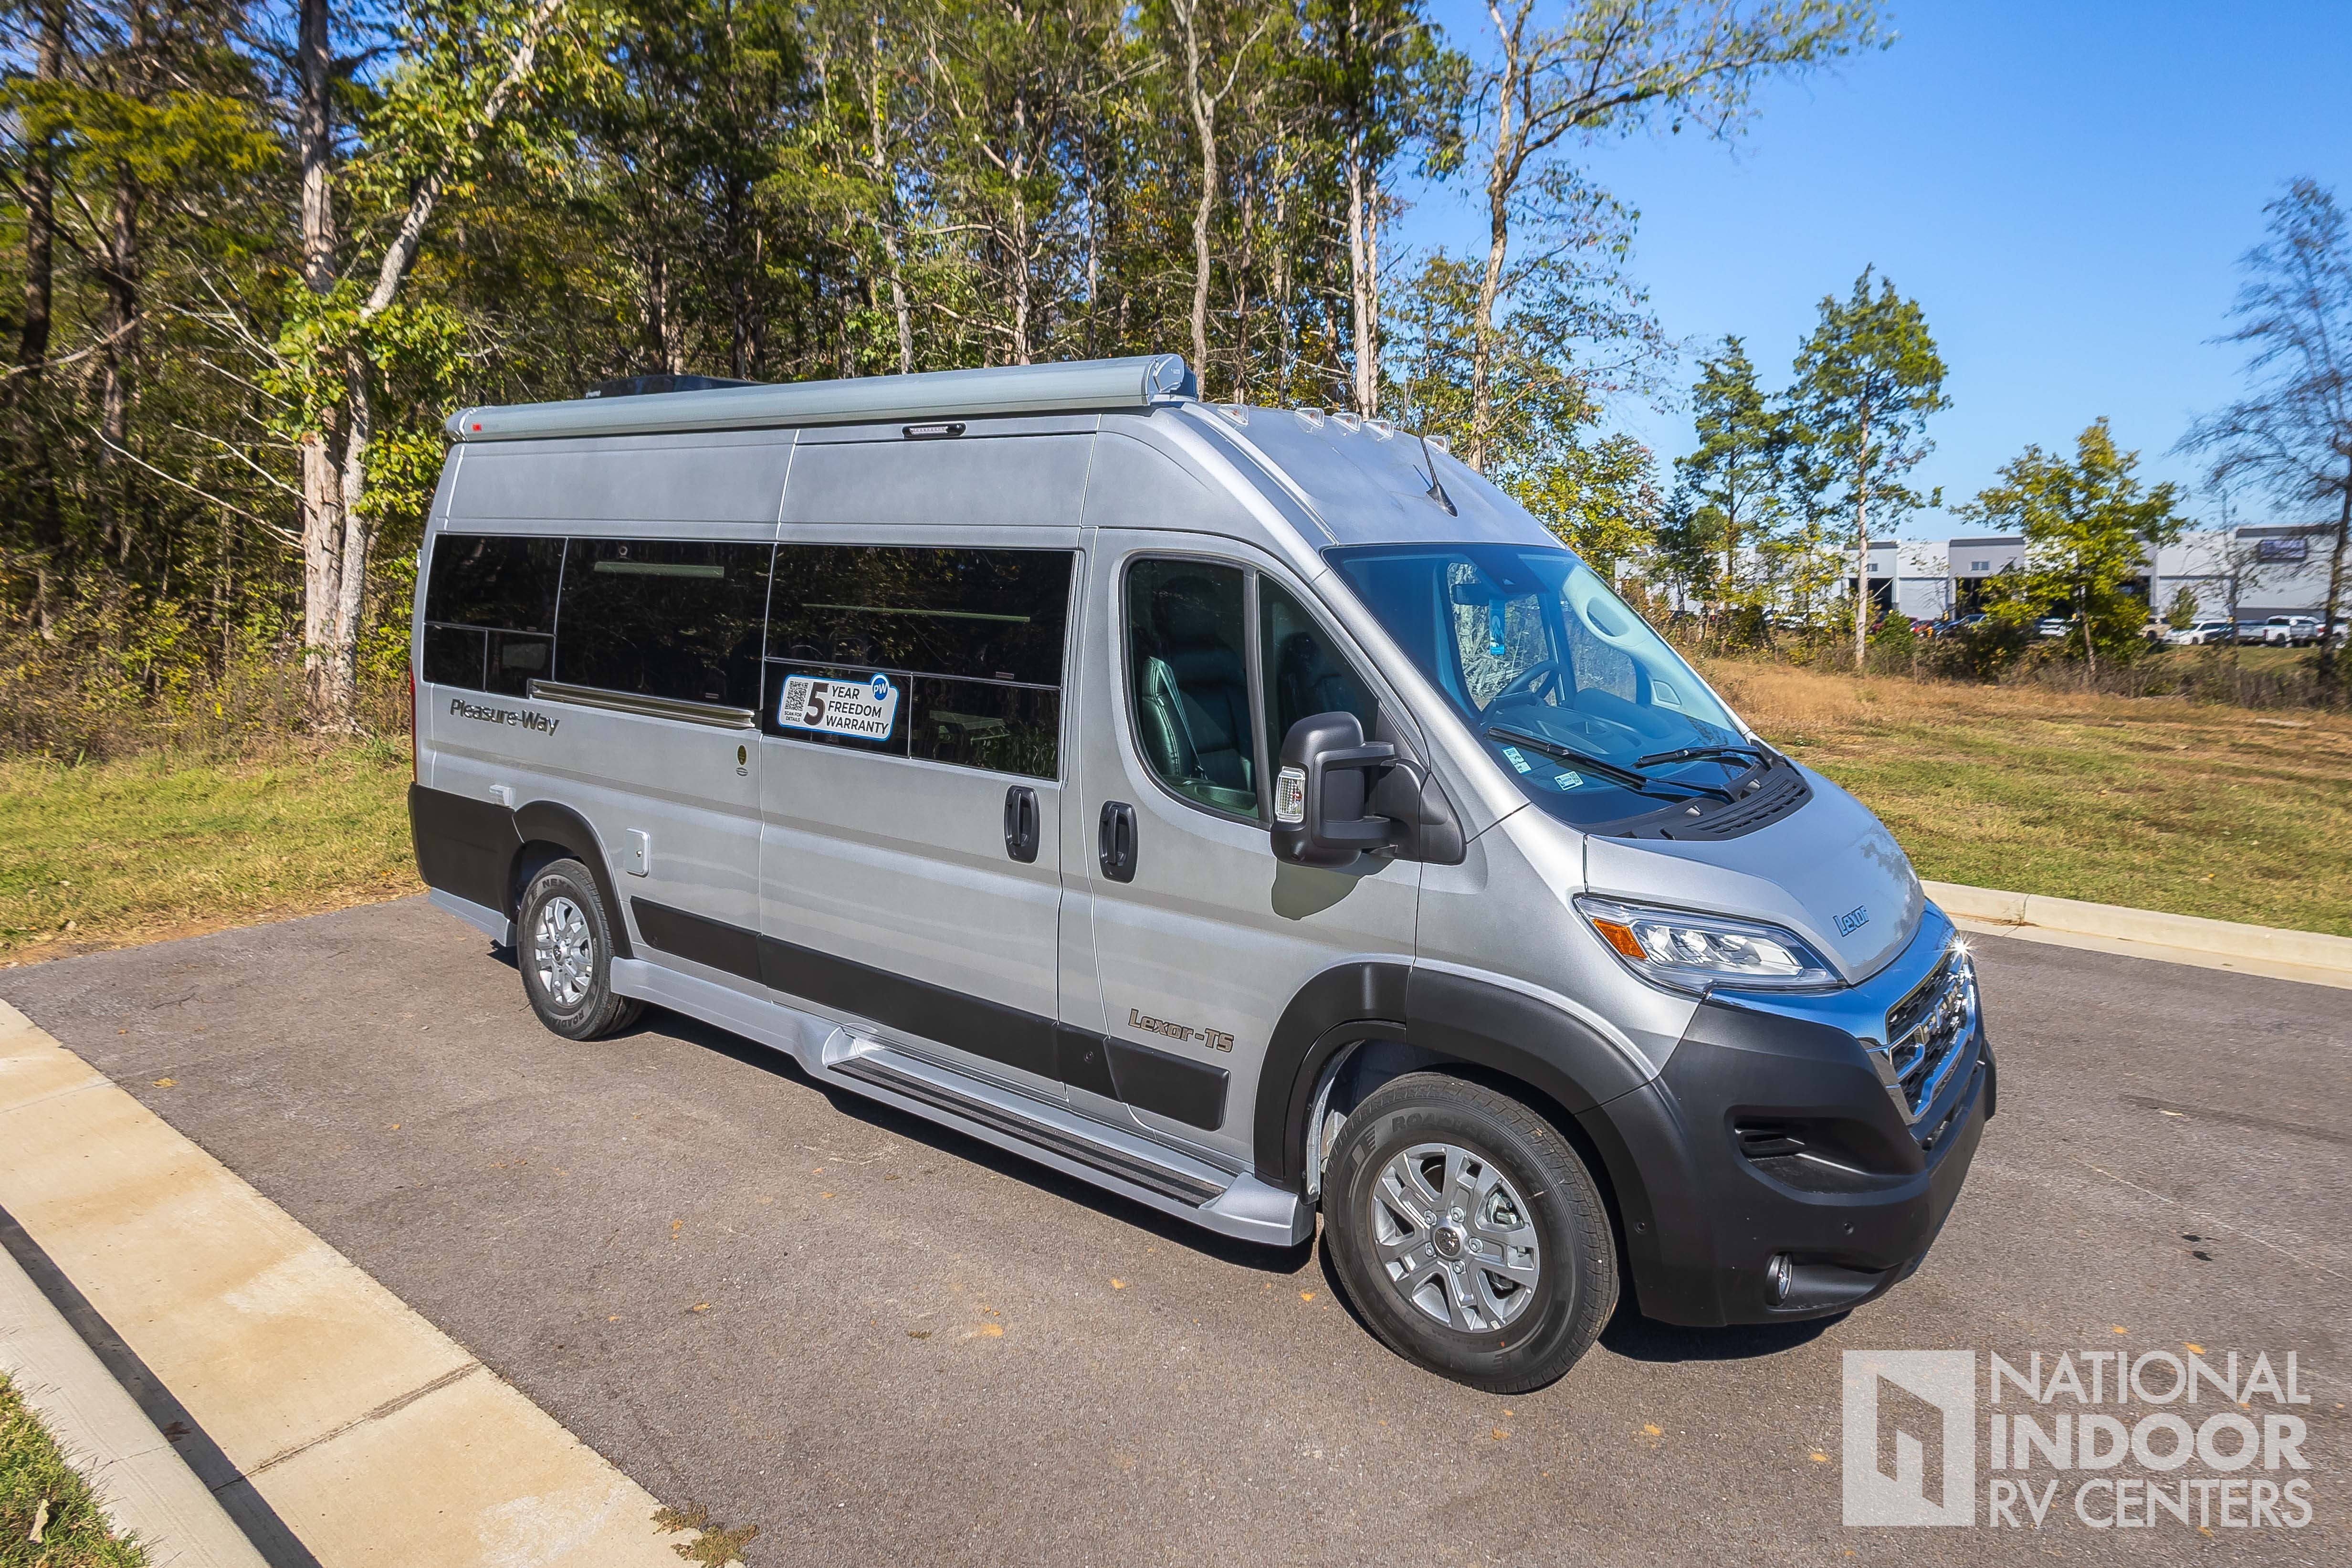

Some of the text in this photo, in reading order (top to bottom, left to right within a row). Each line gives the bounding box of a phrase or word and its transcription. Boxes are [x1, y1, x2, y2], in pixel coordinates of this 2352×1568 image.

[832, 685, 860, 700] YEAR
[873, 682, 887, 696] PW
[803, 682, 830, 726] 5
[828, 700, 882, 718] FREEDOM
[450, 698, 560, 737] Pleasure-Way
[826, 715, 889, 735] WARRANTY
[1833, 905, 1869, 937] Lexor
[1128, 1008, 1234, 1053] Lexor-TS
